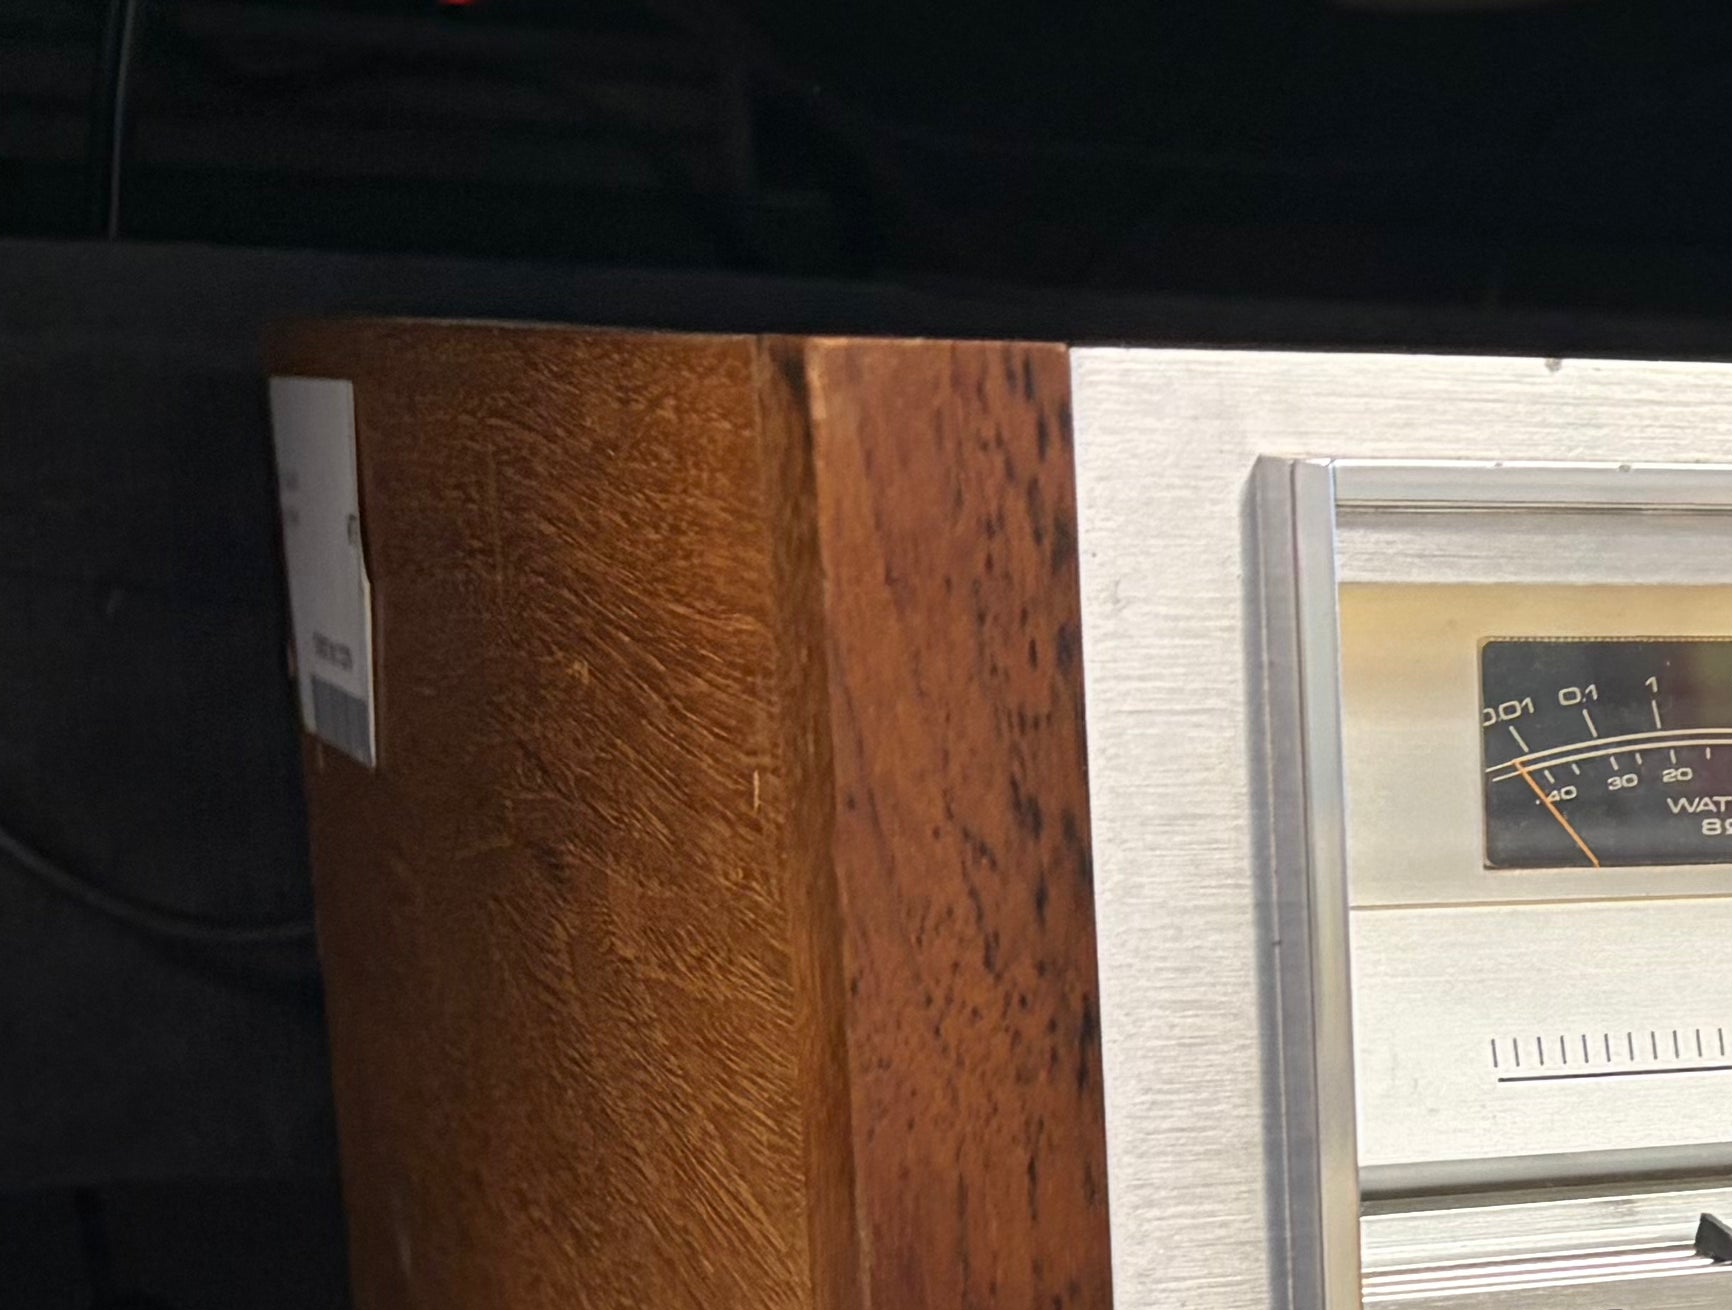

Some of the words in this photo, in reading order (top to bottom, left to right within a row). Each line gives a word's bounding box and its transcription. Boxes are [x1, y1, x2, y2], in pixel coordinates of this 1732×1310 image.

[1646, 677, 1658, 694] 1
[1547, 785, 1577, 802] 40
[1607, 773, 1639, 790] 30
[1662, 767, 1693, 783] 20
